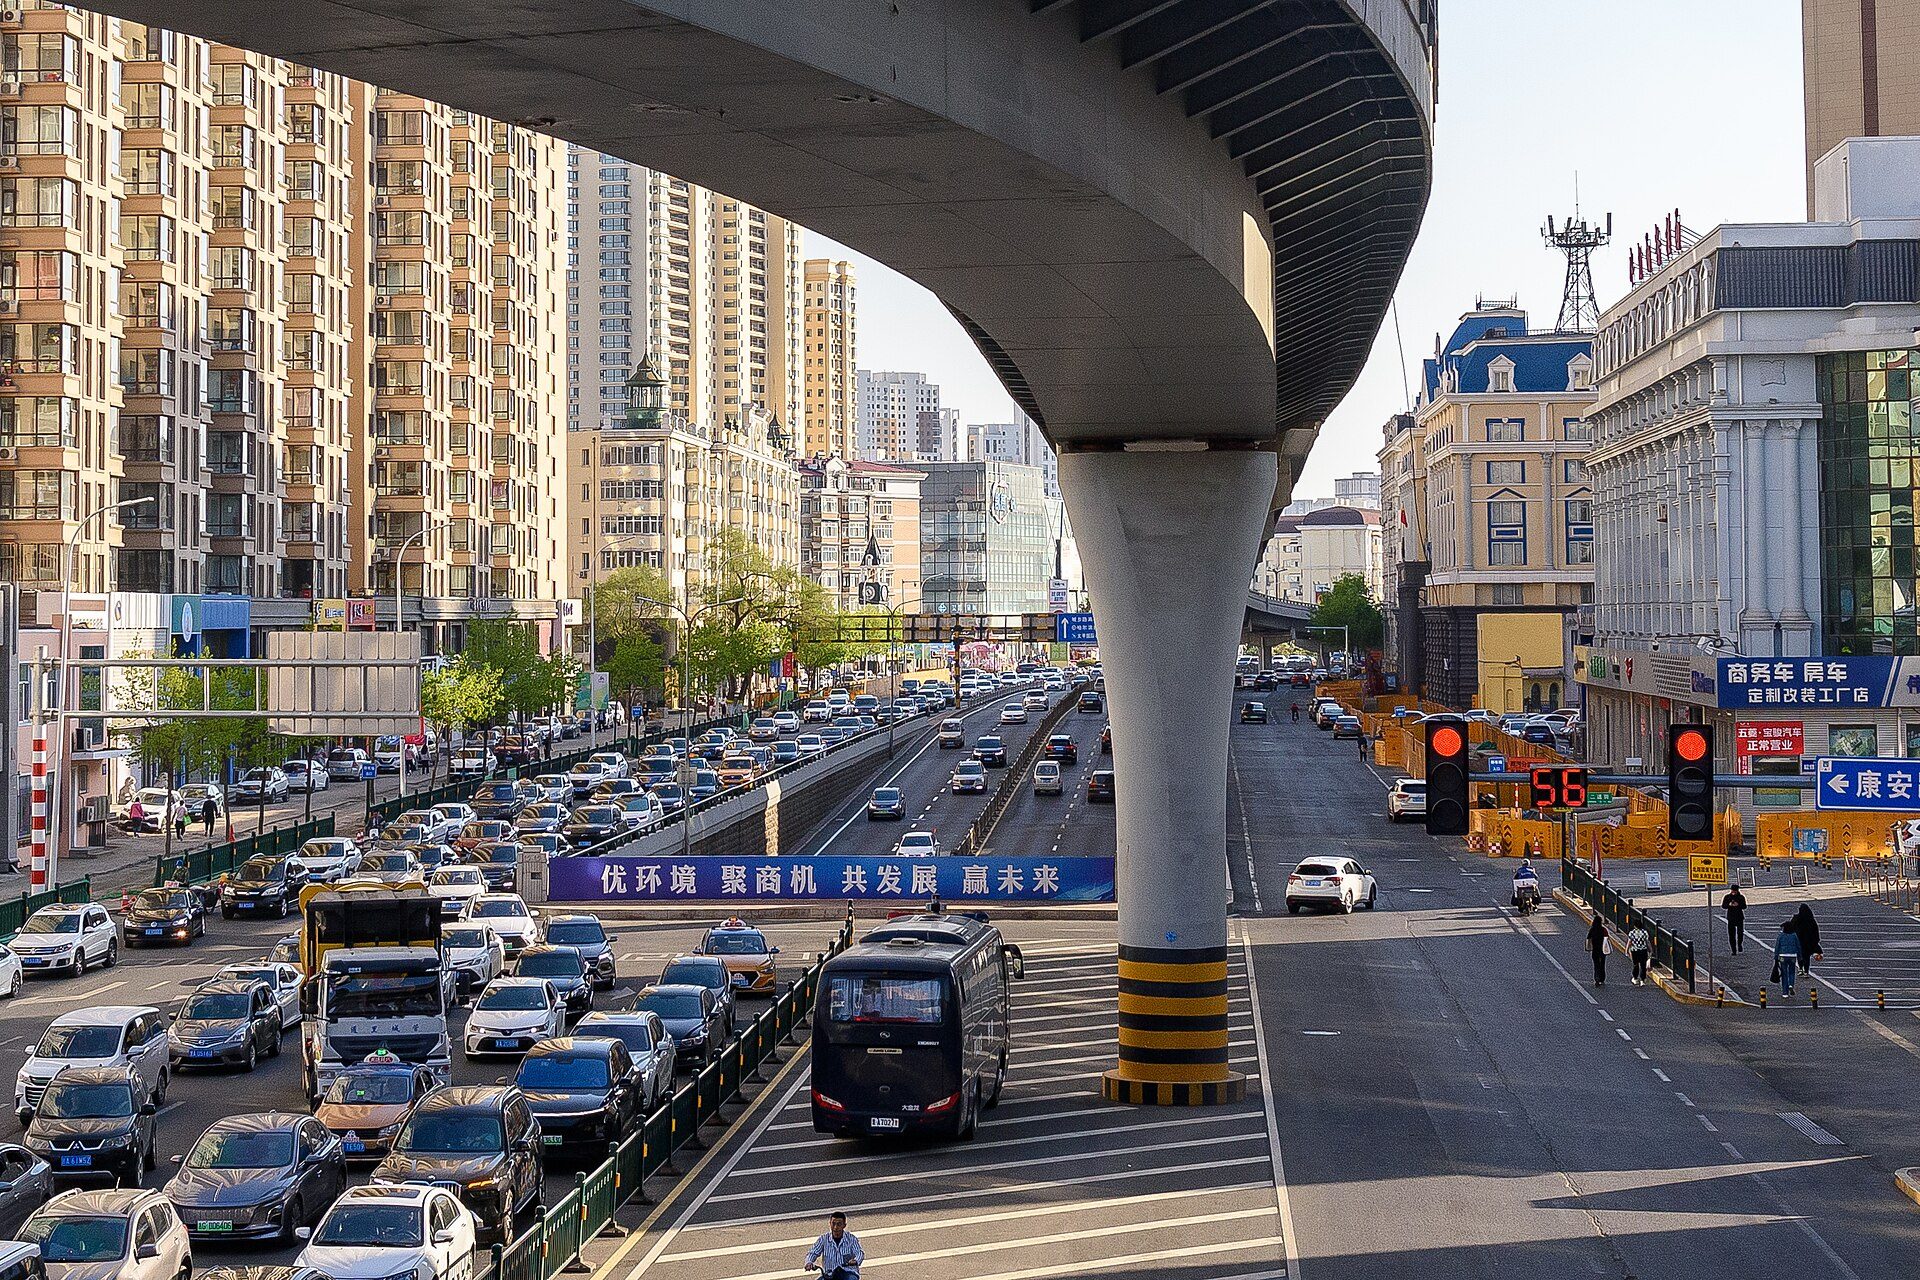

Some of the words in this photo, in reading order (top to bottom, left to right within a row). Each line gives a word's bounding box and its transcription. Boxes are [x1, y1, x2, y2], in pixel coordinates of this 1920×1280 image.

[1727, 662, 1794, 684] 商务车
[1803, 662, 1848, 683] 房车
[1747, 688, 1869, 703] 定制改装工厂店
[1746, 739, 1794, 751] 正常营业
[1533, 768, 1586, 807] 56
[1855, 769, 1920, 800] 康安
[601, 864, 697, 894] 优环境
[721, 864, 817, 894] 聚商机
[841, 864, 938, 894] 共发展
[962, 864, 1060, 895] 赢未来
